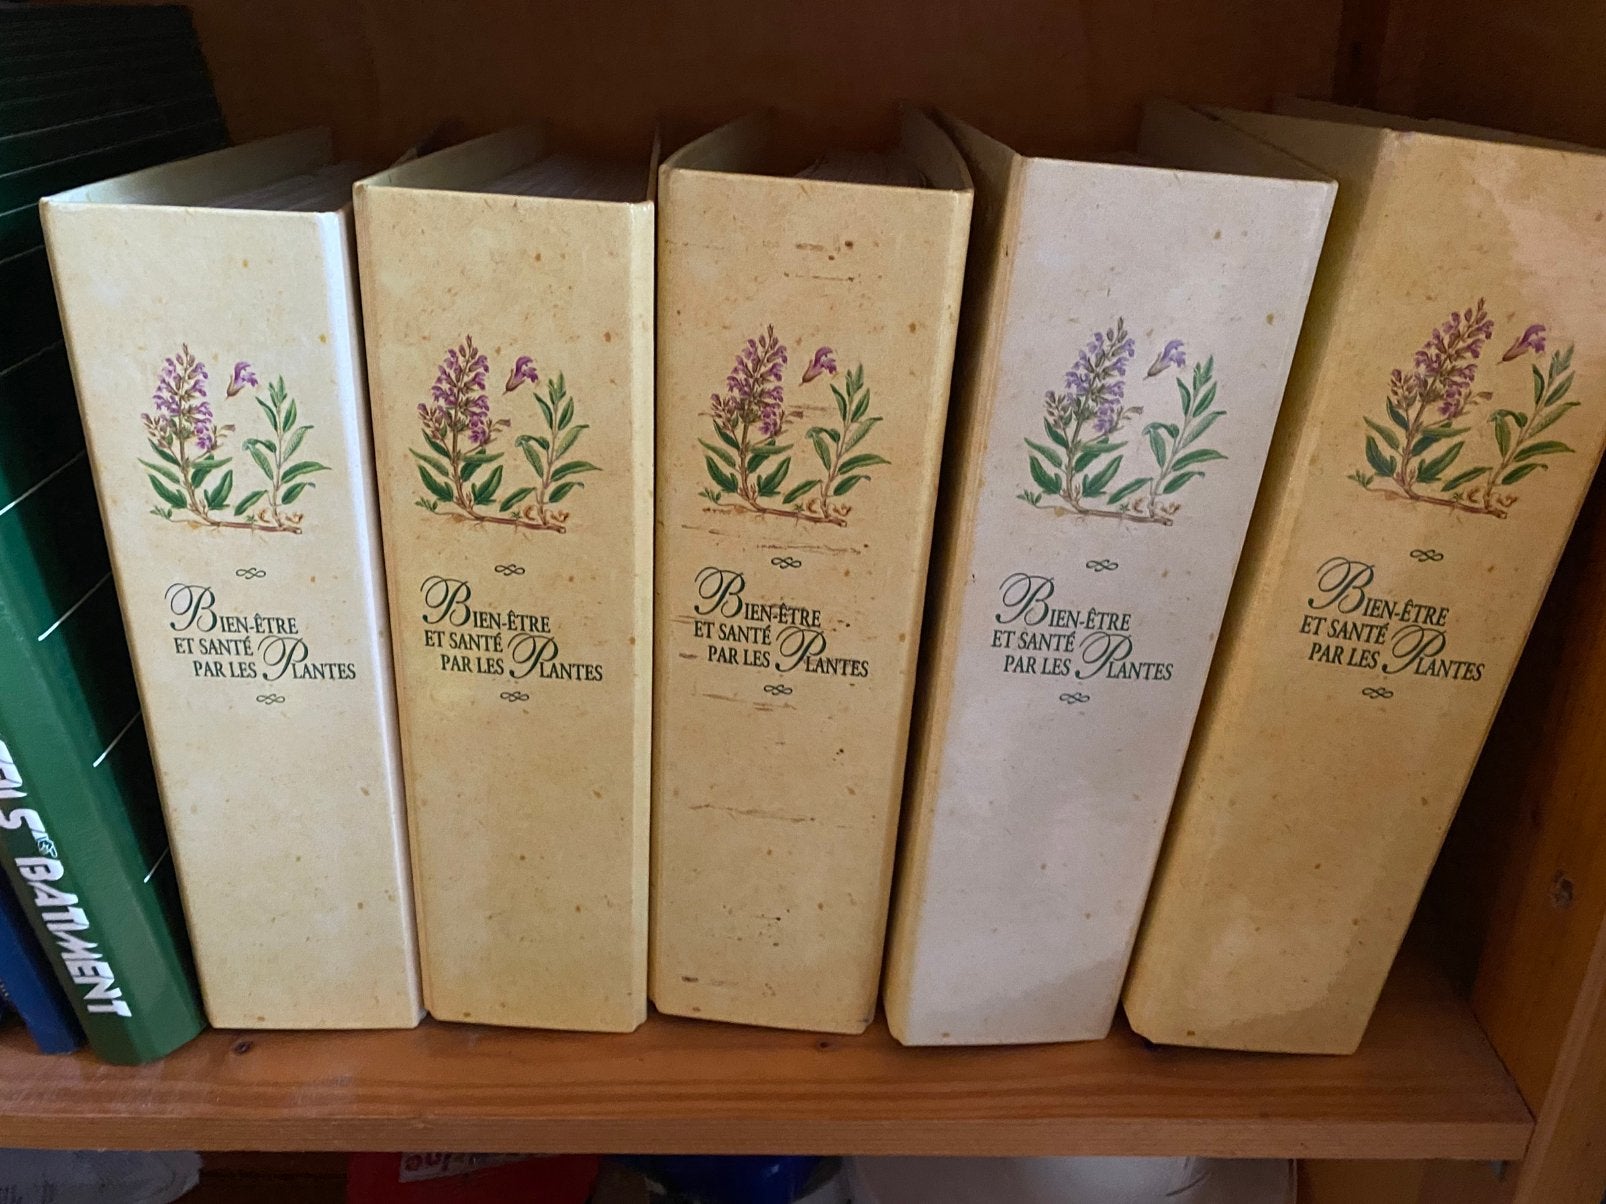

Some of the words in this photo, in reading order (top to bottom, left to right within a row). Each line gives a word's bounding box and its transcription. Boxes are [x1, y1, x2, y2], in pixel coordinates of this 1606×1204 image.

[165, 583, 299, 634] BIEN-ÊTRE
[420, 575, 551, 633] BIEN-ÊTRE
[694, 567, 821, 627] BIEN-ÊTRE
[995, 573, 1131, 631] BIEN-ÊTRE
[1308, 557, 1449, 627] BIEN-ÊTRE
[174, 637, 194, 654] ET
[200, 636, 253, 656] SANTÉ
[424, 630, 445, 647] ET
[450, 632, 503, 653] SANTÉ
[694, 620, 714, 638] ET
[718, 625, 772, 646] SANTÉ
[708, 645, 739, 665] PAR
[743, 649, 771, 668] LES
[775, 626, 869, 678] PLANTES
[991, 630, 1016, 648] ET
[1018, 631, 1076, 652] SANTÉ
[1300, 615, 1327, 636] ET
[1327, 619, 1390, 645] SANTÉ
[1308, 642, 1344, 665] PAR
[1347, 647, 1380, 670] LES
[1382, 625, 1485, 682] PLANTES
[193, 661, 225, 678] PAR
[230, 662, 257, 679] LES
[258, 635, 356, 681] PLANTES
[440, 654, 473, 673] PAR
[477, 657, 504, 675] LES
[507, 632, 603, 681] PLANTES
[1003, 655, 1037, 675] PAR
[1040, 658, 1072, 676] LES
[1075, 631, 1174, 681] PLANTES
[15, 857, 132, 1017] BATIMENT
